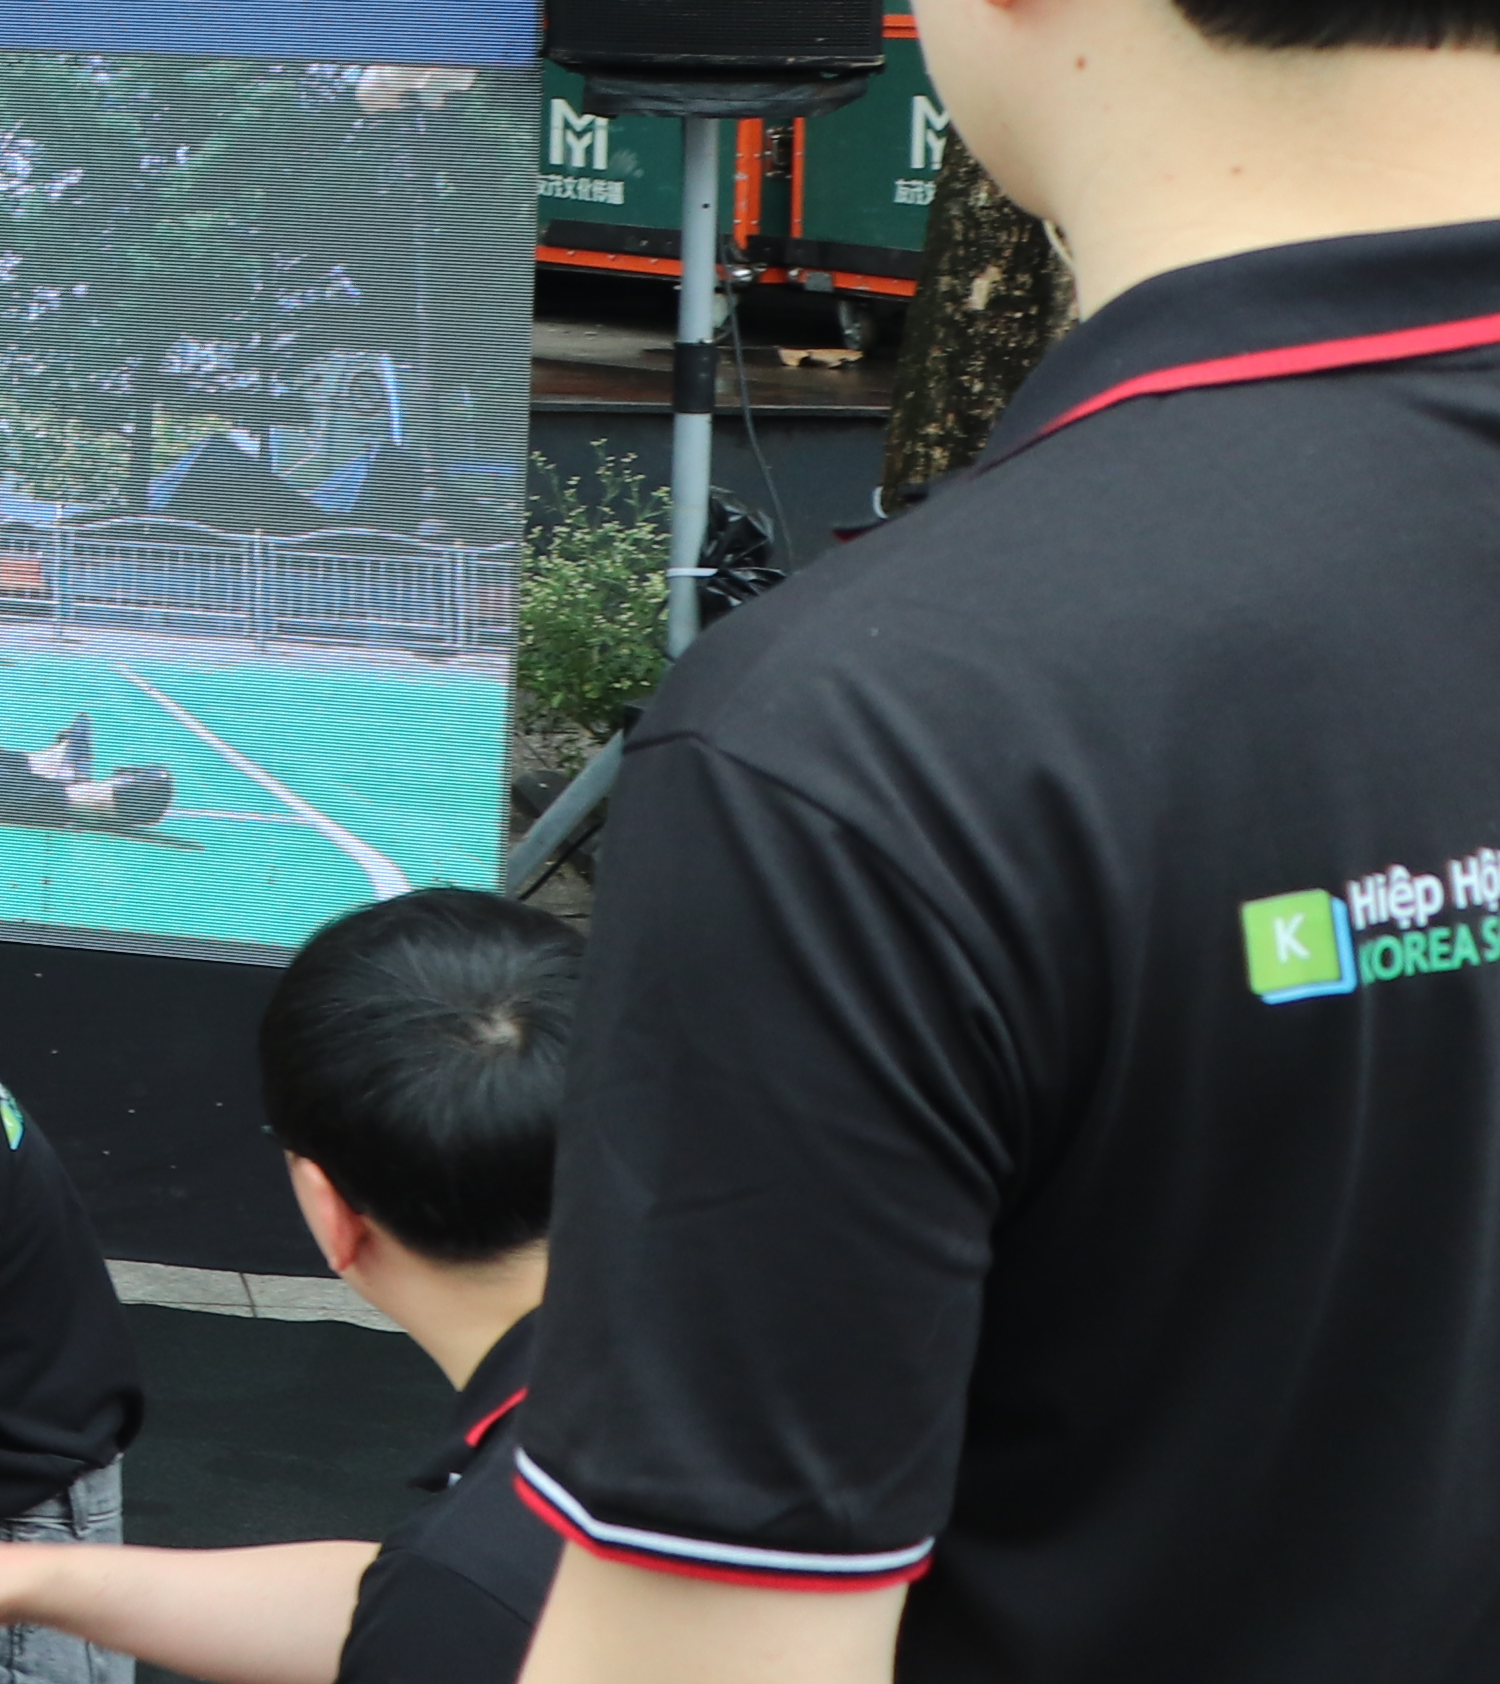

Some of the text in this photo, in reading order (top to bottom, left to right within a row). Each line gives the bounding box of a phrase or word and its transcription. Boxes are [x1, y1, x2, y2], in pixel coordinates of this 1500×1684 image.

[1347, 847, 1500, 932] Hiệp Hộ
[1272, 912, 1312, 965] K
